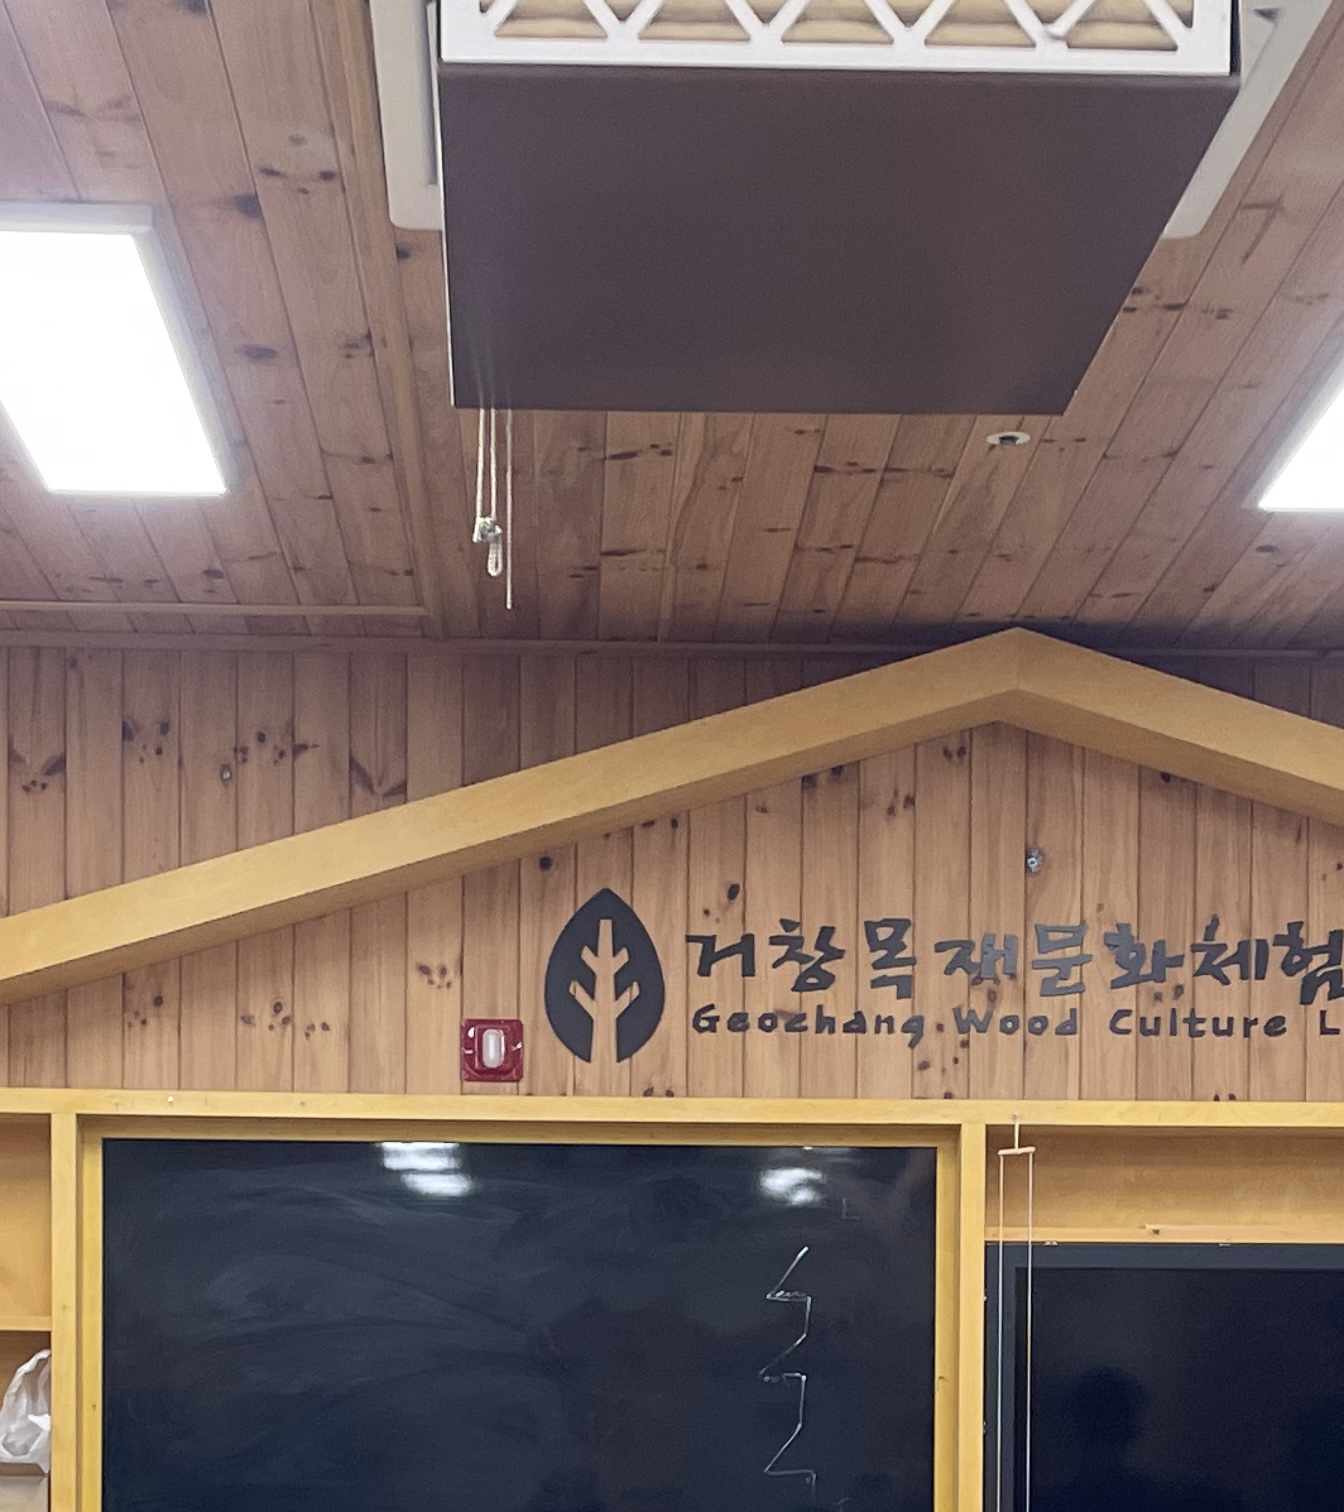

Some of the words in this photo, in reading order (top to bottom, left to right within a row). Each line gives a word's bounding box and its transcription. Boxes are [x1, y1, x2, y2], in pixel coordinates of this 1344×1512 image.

[692, 1003, 924, 1049] Geochang
[954, 1006, 1079, 1035] Wood
[1108, 1007, 1287, 1038] Culture
